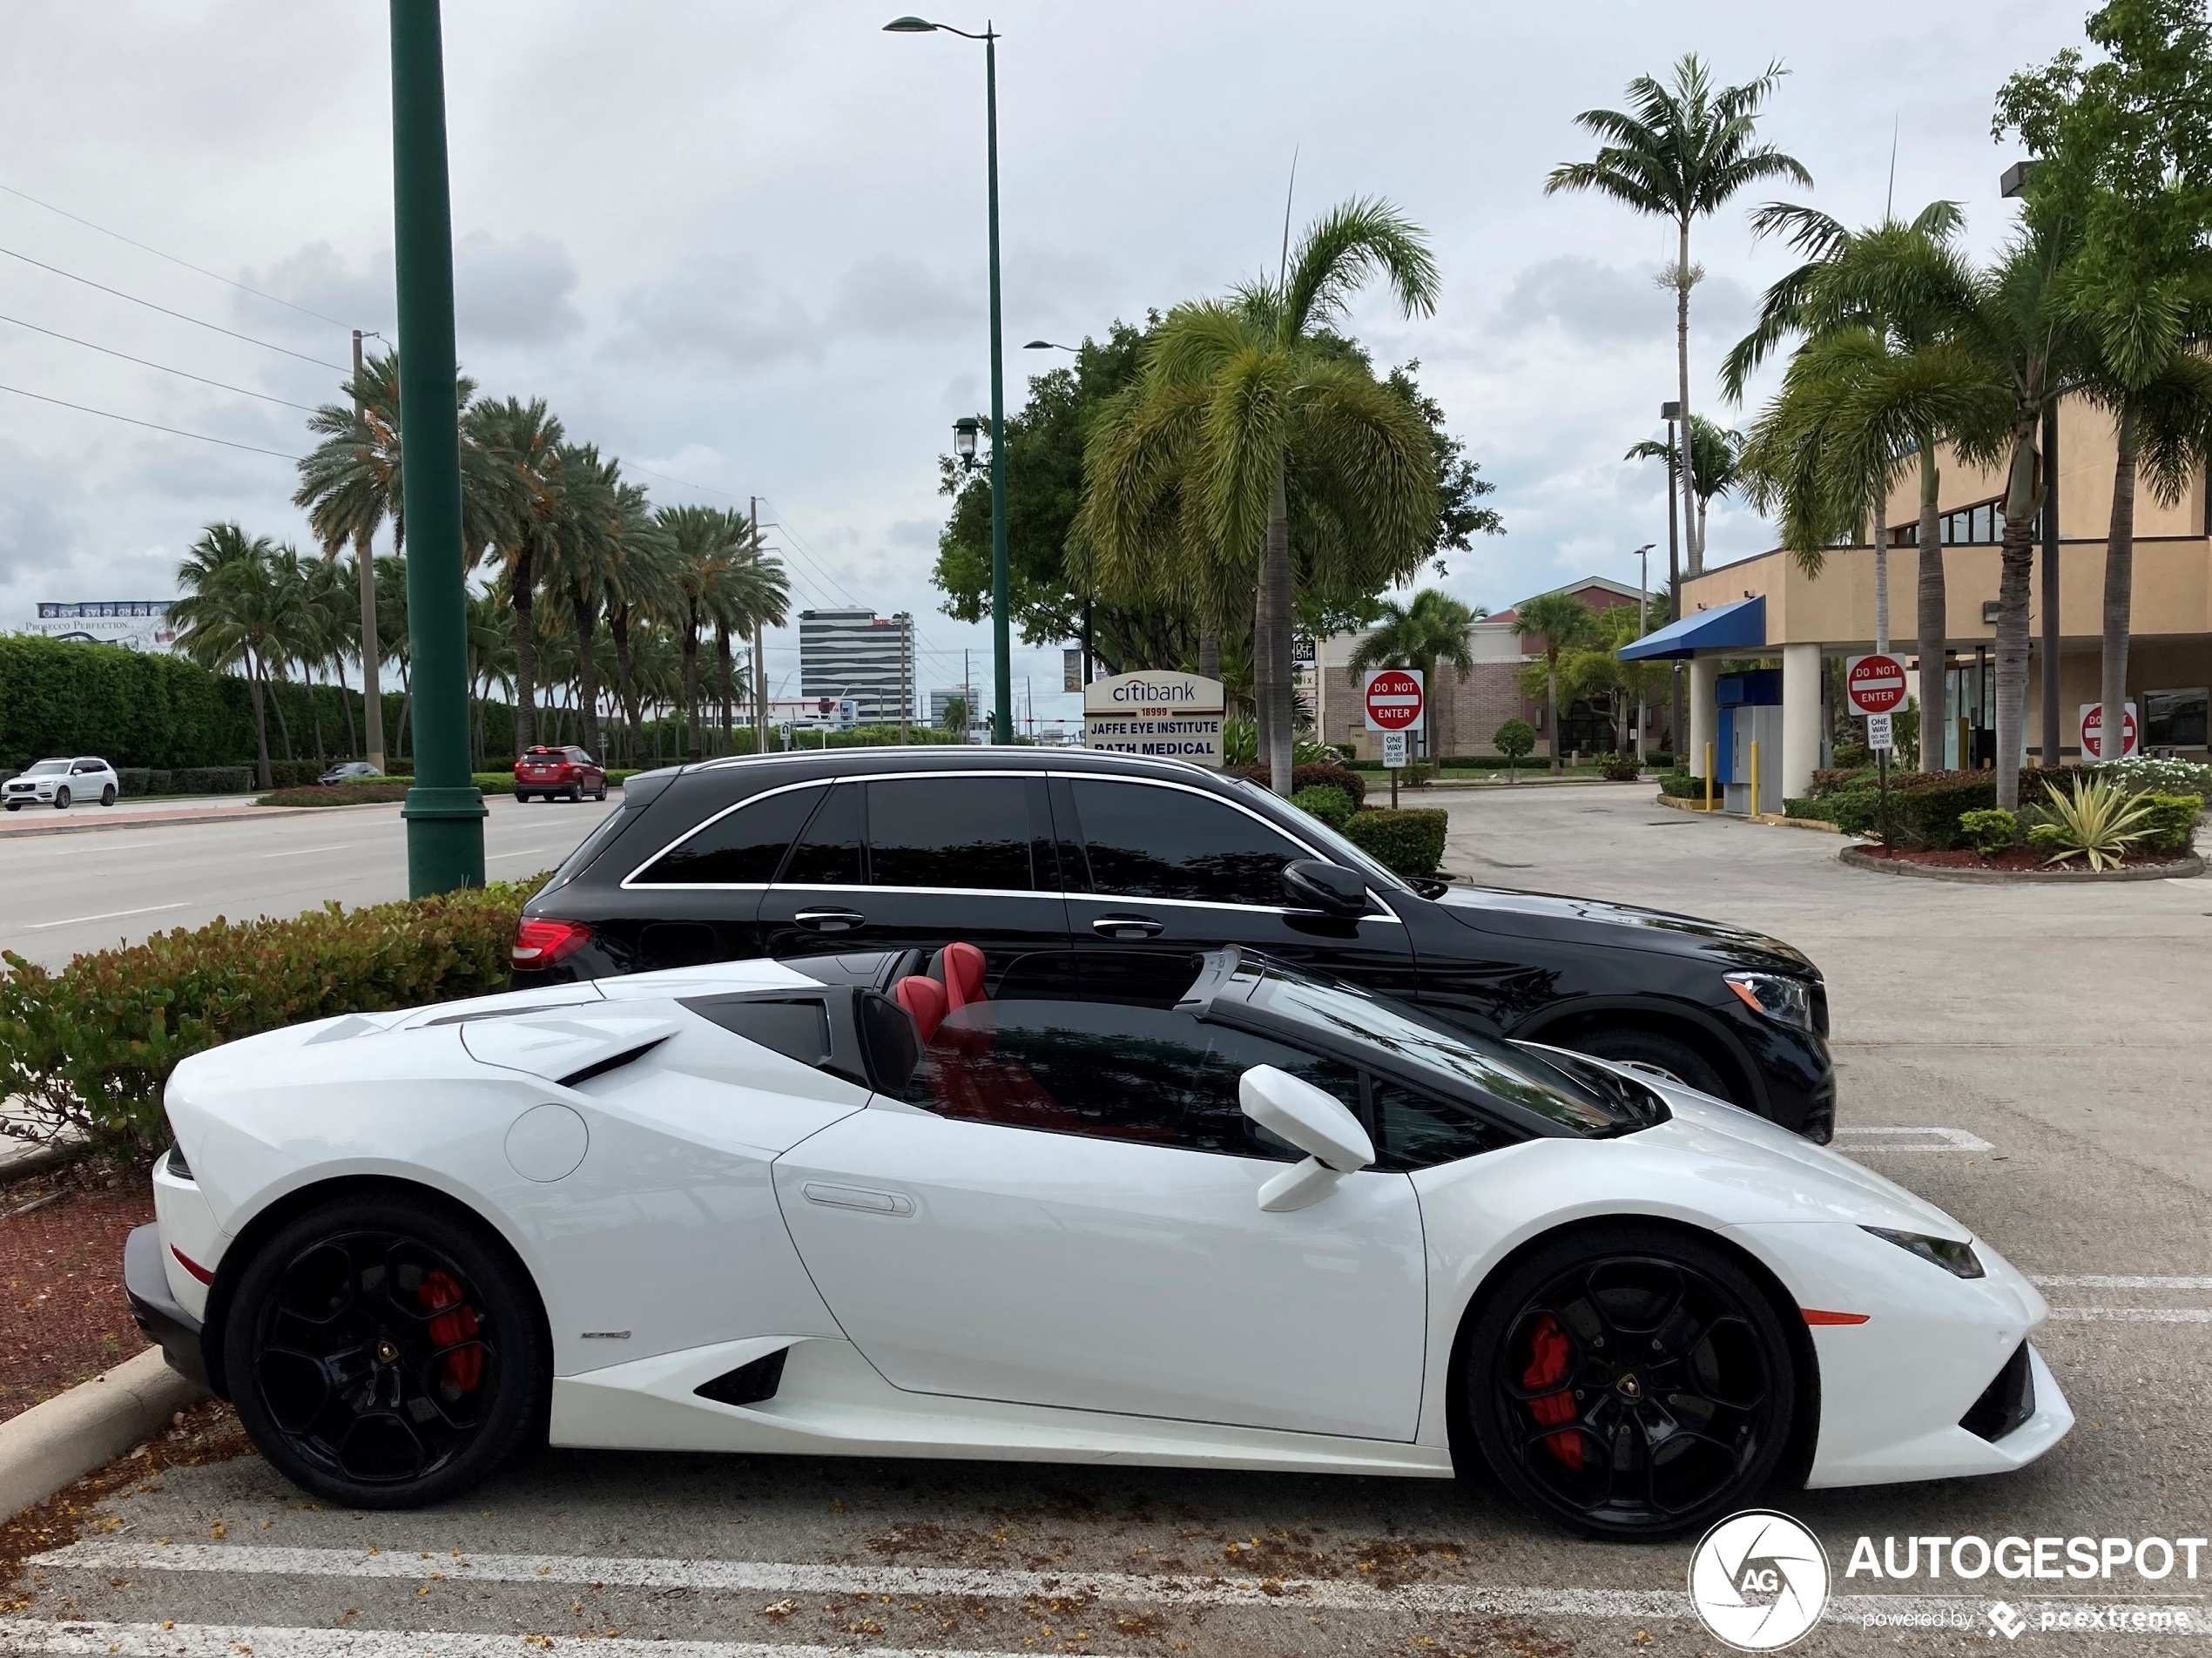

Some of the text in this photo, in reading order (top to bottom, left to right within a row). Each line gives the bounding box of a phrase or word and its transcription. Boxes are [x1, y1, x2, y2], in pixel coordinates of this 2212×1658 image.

[1856, 665, 1897, 677] DO NOT
[1113, 680, 1196, 701] citibank
[1374, 683, 1413, 692] DO NOT
[1861, 691, 1894, 703] ENTER
[1142, 707, 1168, 717] 18999
[1378, 709, 1410, 718] ENTER
[2089, 716, 2101, 725] DO
[1090, 722, 1217, 734] JAFFE EYE INSTITUTE
[1142, 742, 1215, 757] MEDICAL
